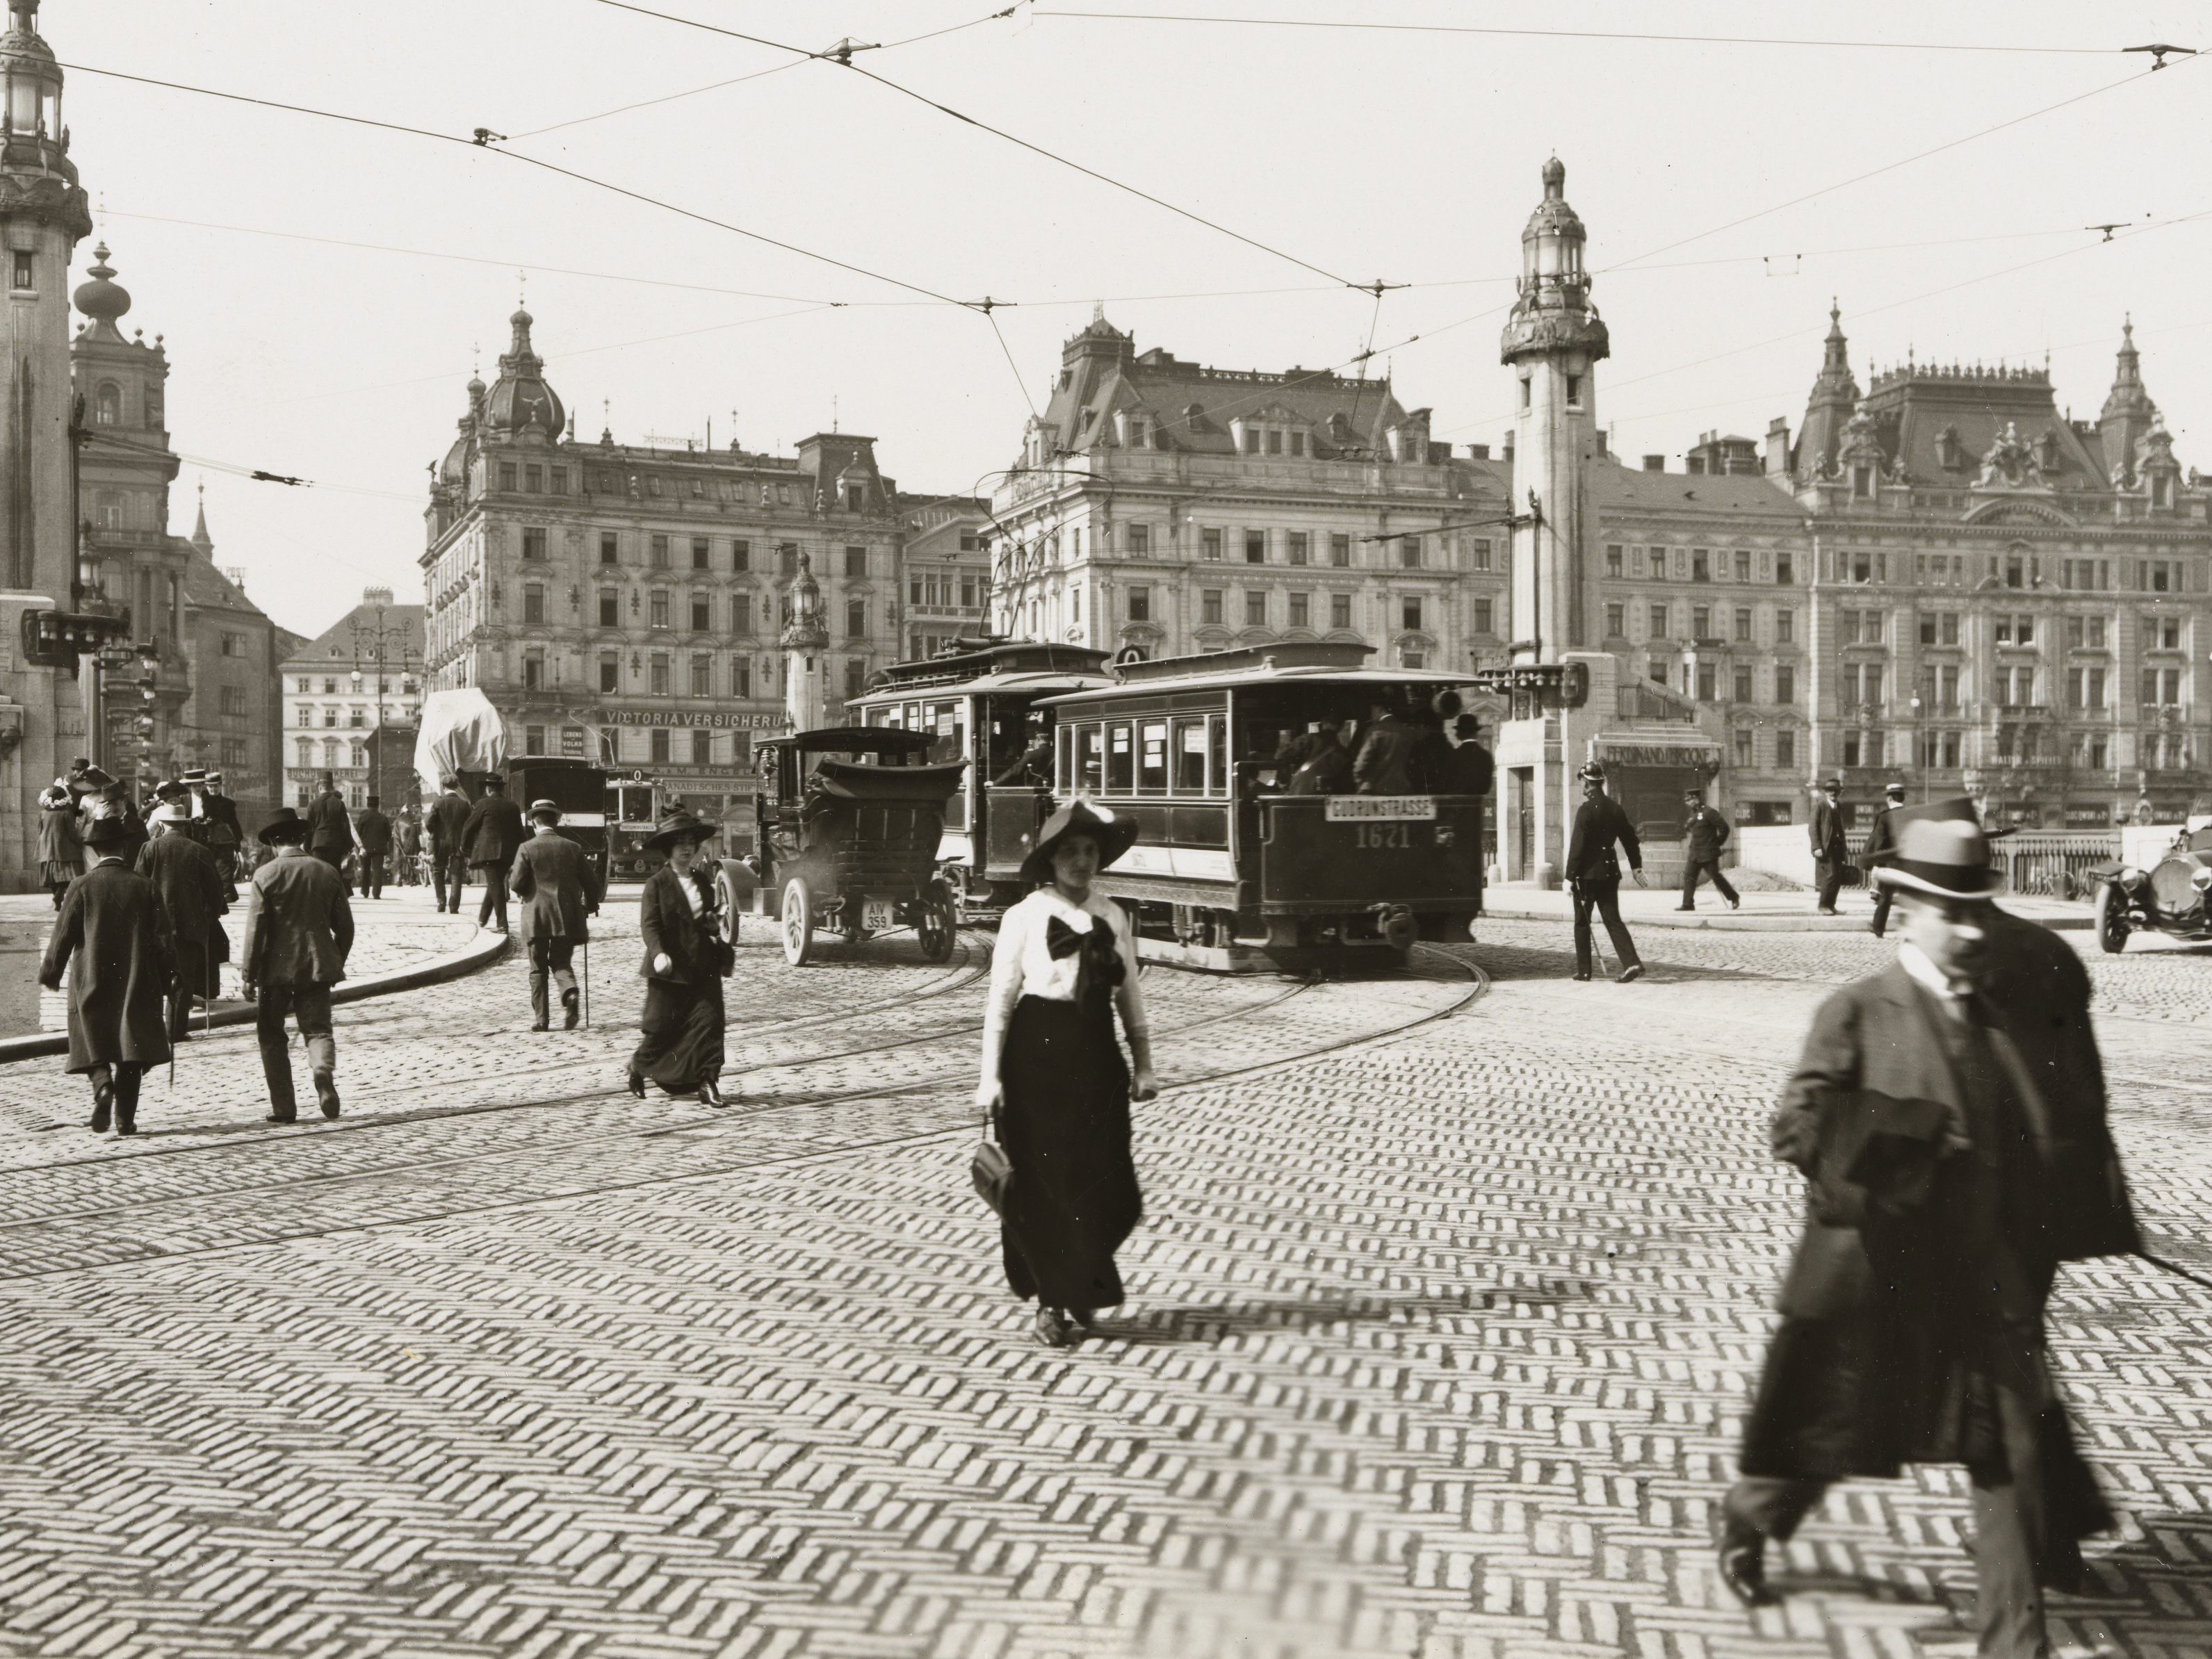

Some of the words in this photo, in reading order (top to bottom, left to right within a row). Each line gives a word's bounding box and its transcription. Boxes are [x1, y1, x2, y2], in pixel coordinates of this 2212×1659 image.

[607, 711, 678, 725] VICTORIA
[683, 712, 781, 728] VERSICHERU
[287, 768, 358, 778] BUCHDKEREI
[1357, 824, 1410, 848] 1671
[868, 916, 886, 929] 359
